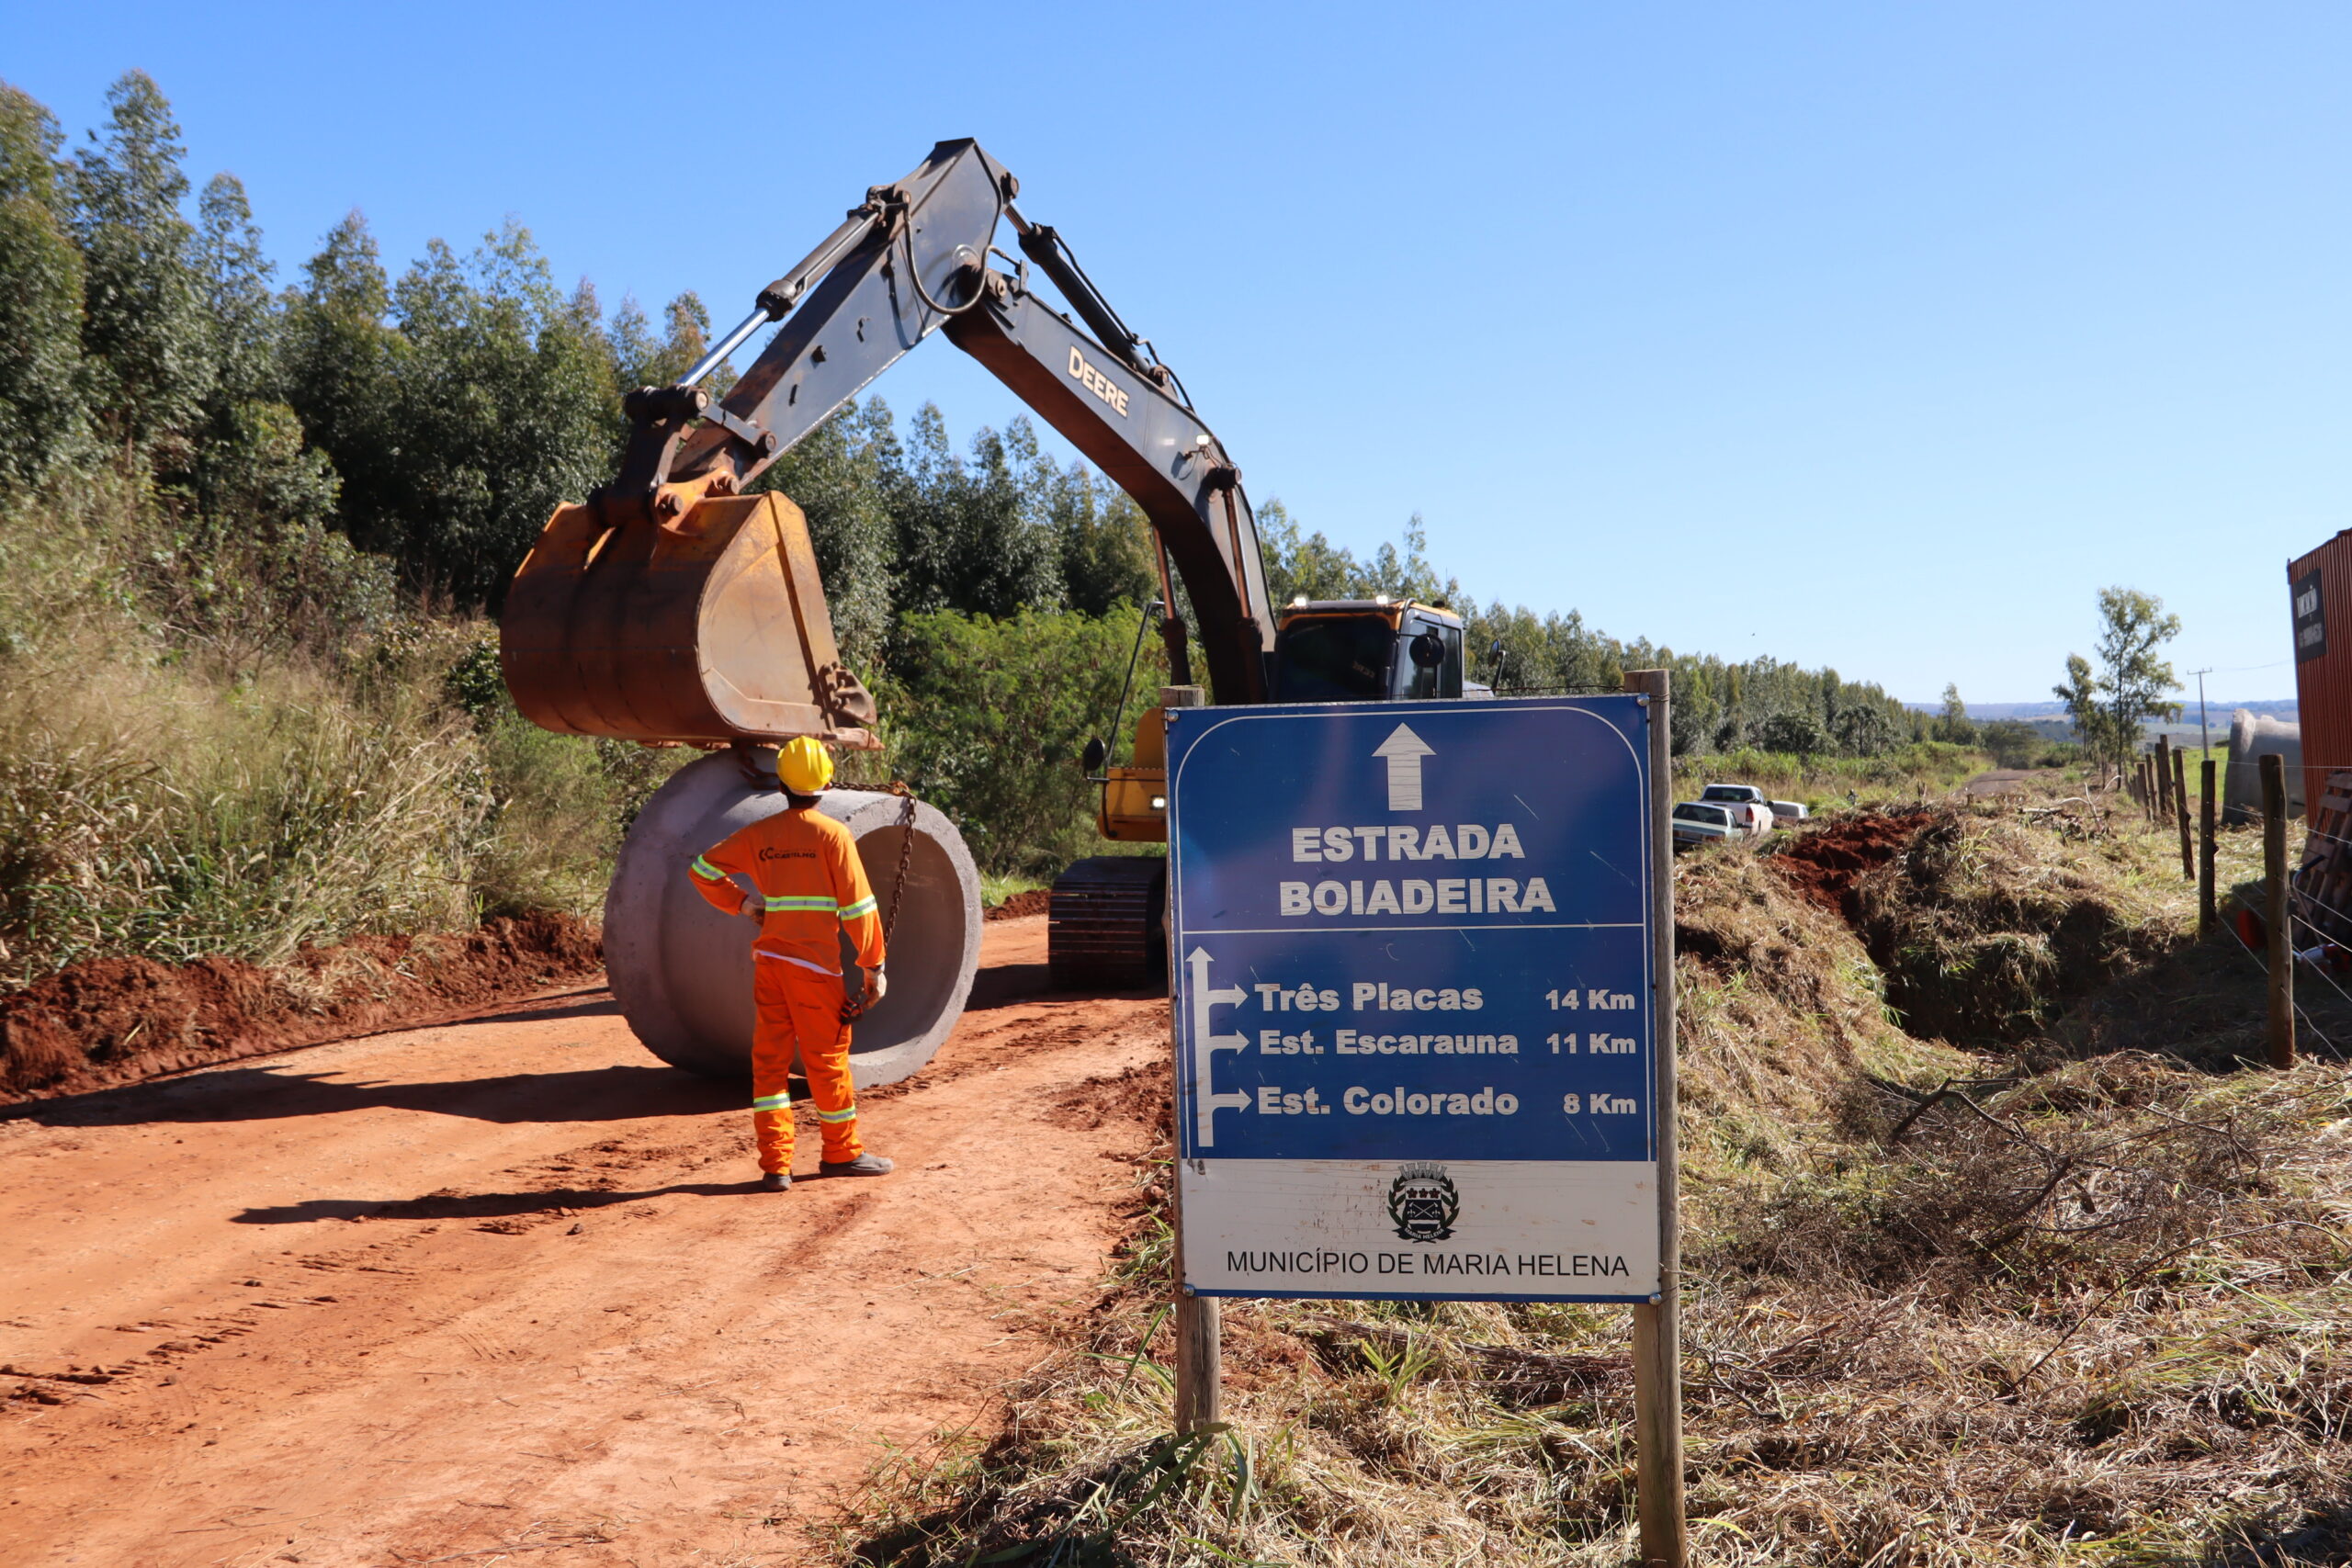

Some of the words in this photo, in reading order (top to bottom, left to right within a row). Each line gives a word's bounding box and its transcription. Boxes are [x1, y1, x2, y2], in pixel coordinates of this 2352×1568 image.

[1069, 345, 1129, 417] DEERE
[1293, 824, 1524, 862] ESTRADA
[1280, 878, 1555, 916] BOIADEIRA
[1255, 983, 1339, 1010] Três
[1353, 983, 1483, 1010] Placas
[1546, 990, 1578, 1010] 14
[1589, 990, 1634, 1009] Km
[1261, 1031, 1323, 1054] Est.
[1337, 1030, 1518, 1054] Escarauna
[1547, 1033, 1576, 1053] 11
[1590, 1034, 1635, 1053] Km
[1259, 1088, 1329, 1114] Est.
[1344, 1087, 1518, 1114] Colorado
[1564, 1094, 1579, 1113] 8
[1590, 1094, 1635, 1113] Km
[1404, 1227, 1421, 1239] MARIA
[1422, 1228, 1444, 1239] HELENA
[1227, 1247, 1368, 1274] MUNICÍPIO
[1379, 1254, 1413, 1274] DE
[1424, 1254, 1510, 1275] MARIA
[1519, 1255, 1629, 1276] HELENA
